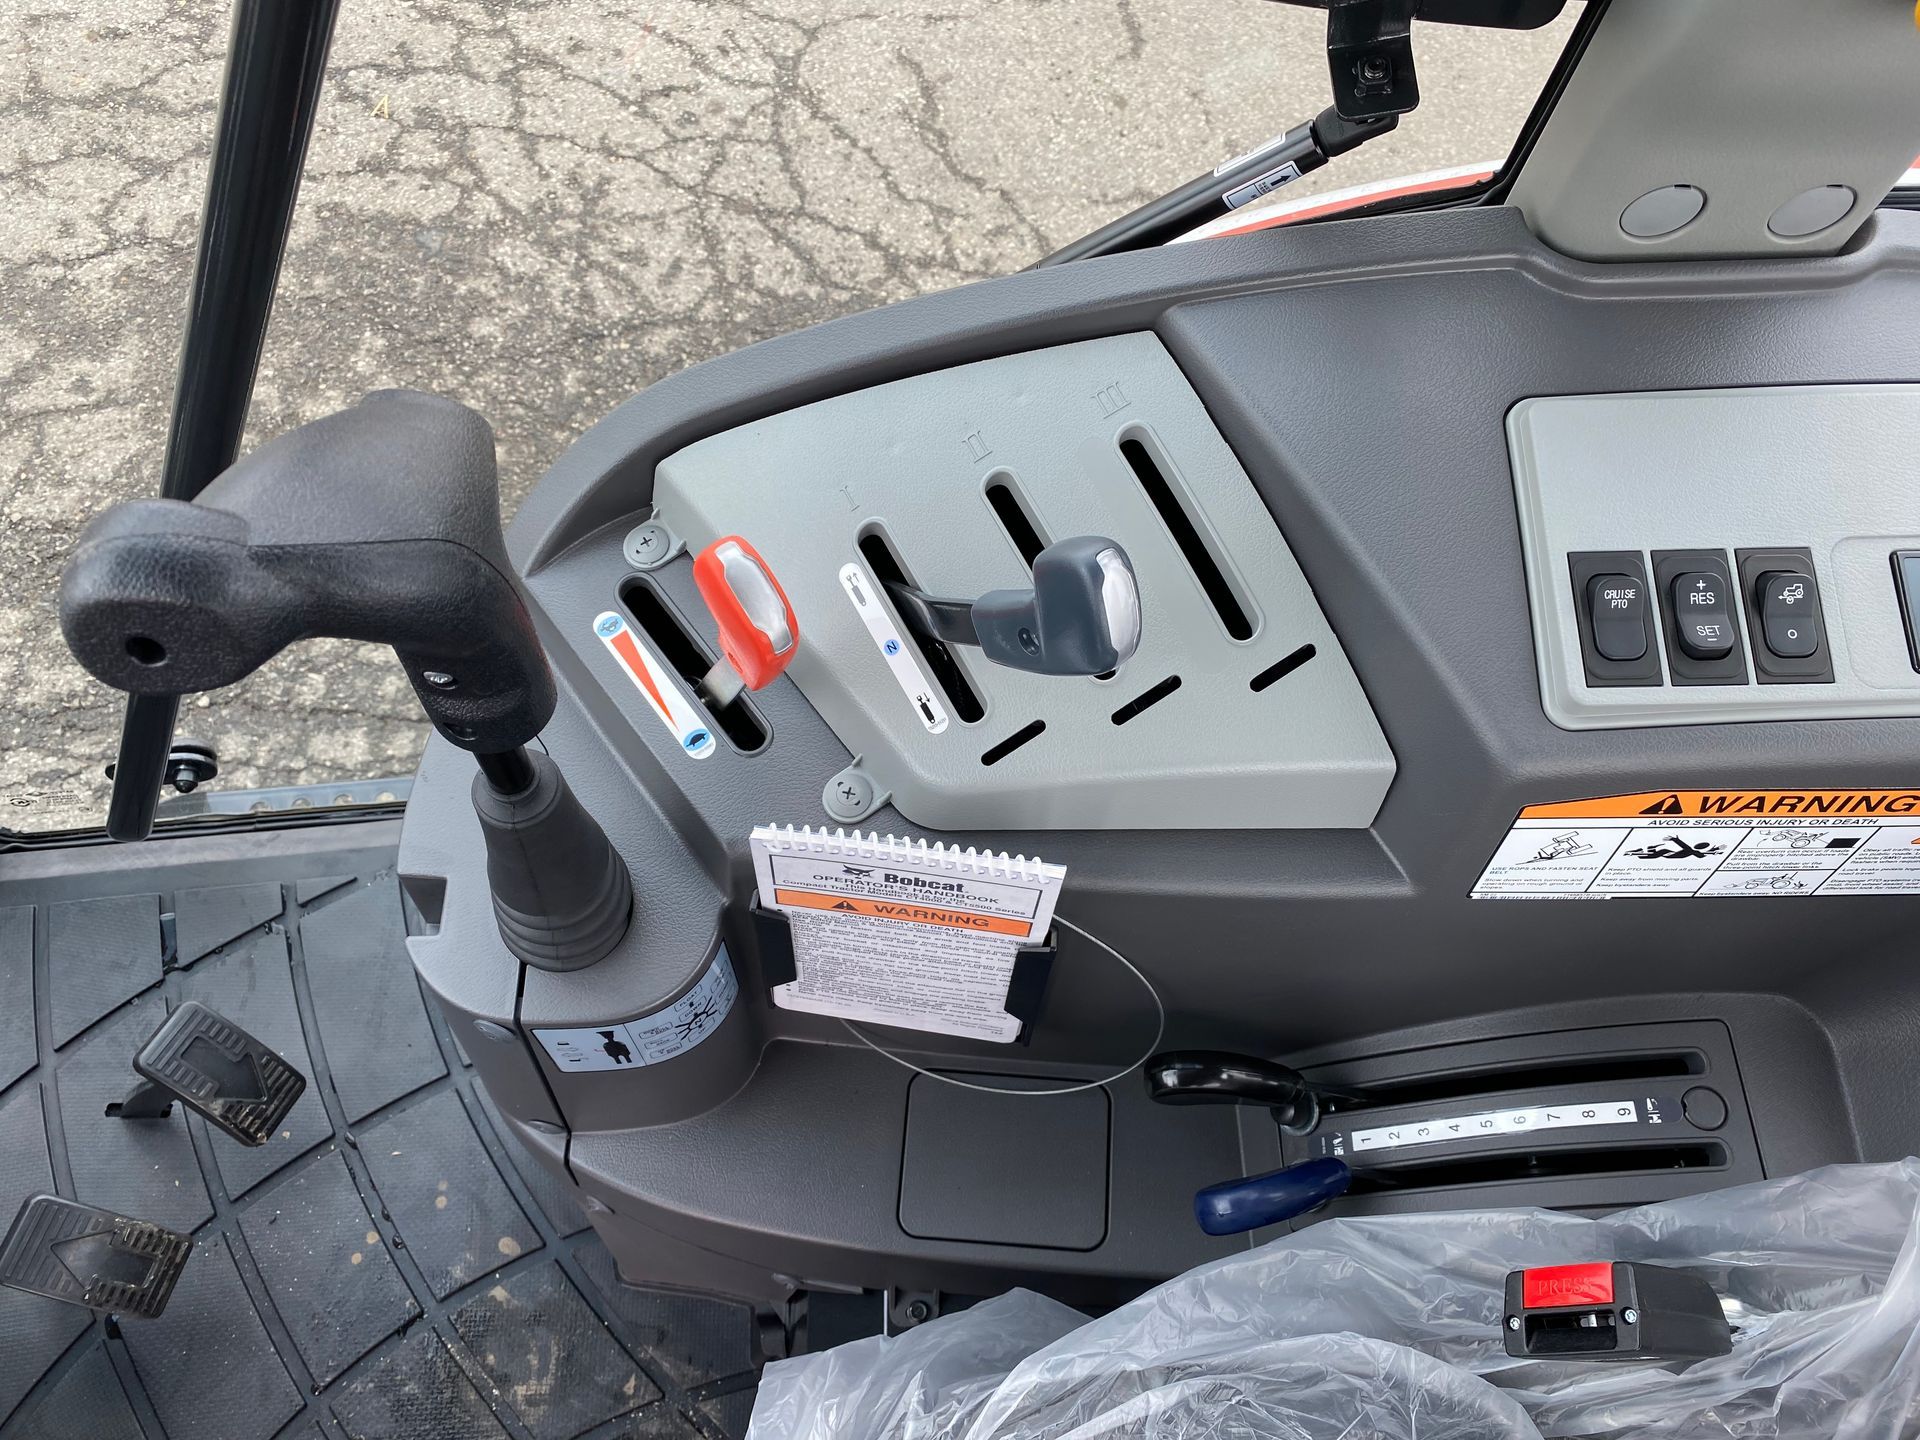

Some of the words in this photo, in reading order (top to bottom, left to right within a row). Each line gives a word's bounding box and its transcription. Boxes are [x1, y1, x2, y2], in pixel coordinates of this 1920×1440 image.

[1604, 589, 1636, 600] CRUISE
[1611, 599, 1628, 609] PTO
[1690, 593, 1715, 605] RES
[1696, 625, 1721, 637] SET
[1699, 795, 1920, 813] WARNING
[783, 879, 827, 889] Compact
[831, 884, 865, 893] Tractor
[867, 890, 902, 898] Models
[813, 874, 908, 892] OPERATOR'S
[913, 887, 1000, 904] HANDBOOK
[884, 873, 965, 893] Bobcat
[841, 913, 871, 922] AVOID
[874, 917, 911, 926] INJURY
[913, 922, 928, 930] OR
[930, 925, 964, 933] DEATH
[874, 904, 989, 928] WARNING
[1360, 1135, 1373, 1144] 1
[1388, 1131, 1401, 1140] 2
[1418, 1127, 1430, 1137] 3
[1448, 1123, 1461, 1133] 4
[1480, 1119, 1494, 1129] 5
[1513, 1115, 1527, 1125] 6
[1547, 1112, 1561, 1122] 7
[1582, 1109, 1596, 1119] 8
[1617, 1107, 1632, 1116] 9
[1537, 1277, 1592, 1297] PRESS
